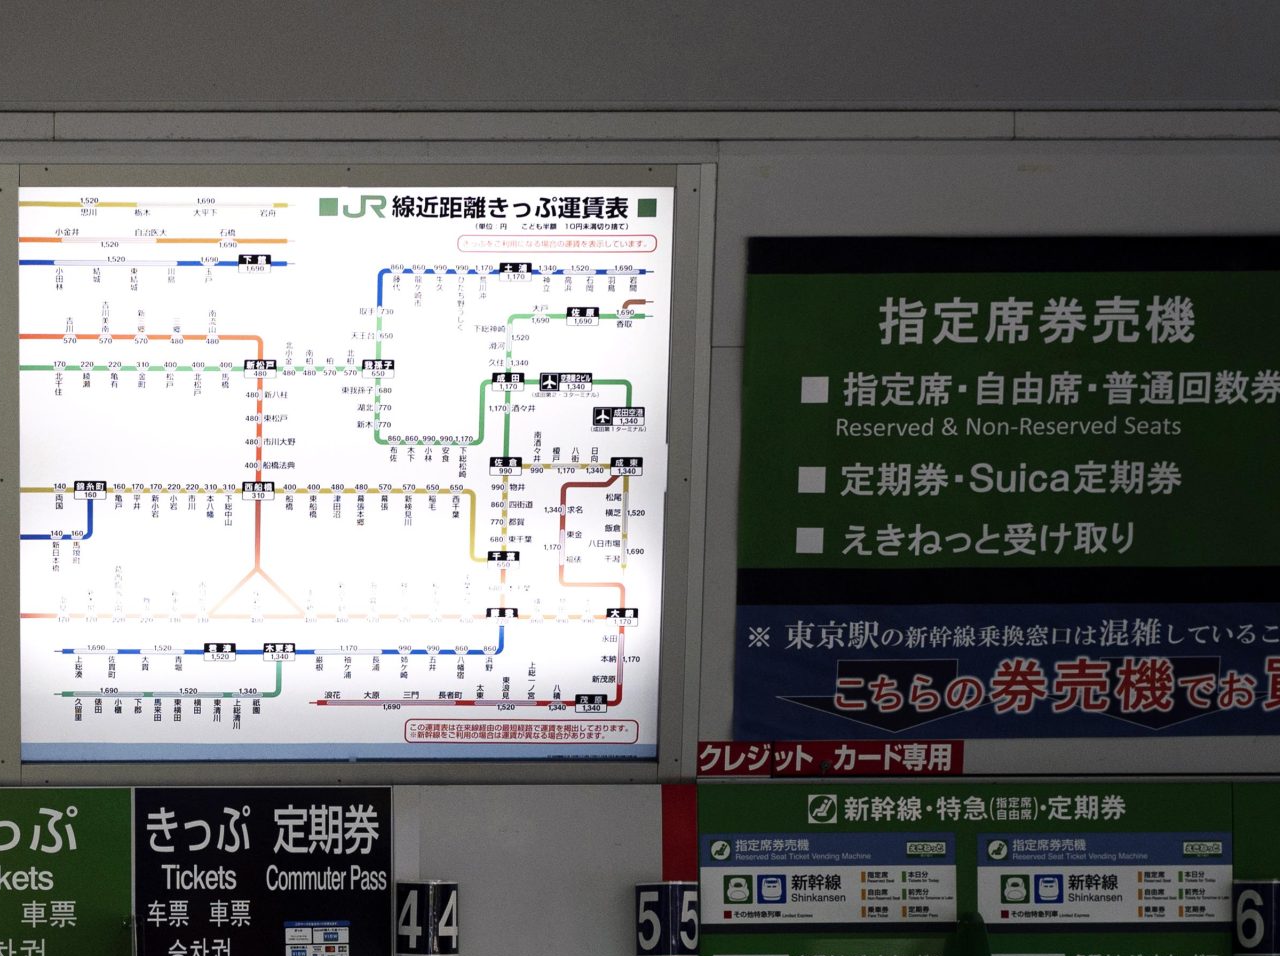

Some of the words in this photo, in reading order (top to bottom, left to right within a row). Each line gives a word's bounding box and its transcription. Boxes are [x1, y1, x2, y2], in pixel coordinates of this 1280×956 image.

[392, 196, 629, 220] 線近距離きっぷ運賃表
[879, 295, 1196, 345] 指定席券売機
[842, 371, 1280, 408] 指定席・自由席・普通回数券
[613, 408, 644, 417] 成田空港
[835, 417, 935, 437] Reserved
[941, 418, 958, 436] &
[966, 416, 1117, 436] Non-Reserved
[1124, 416, 1182, 435] Seats
[263, 437, 296, 446] 市川大野
[840, 461, 1182, 496] 定期券・Suica定期券
[508, 500, 534, 509] 四街道
[841, 522, 1135, 557] えきねっと受け取り
[699, 744, 814, 773] クレジット
[833, 743, 952, 772] カード専用
[145, 805, 251, 854] きっぷ
[272, 805, 380, 855] 定期券
[735, 839, 810, 852] 指定席券売機
[1012, 839, 1087, 852] 指定席券売機
[735, 853, 769, 861] Reserved
[770, 853, 787, 861] Seat
[790, 853, 810, 861] Ticket
[811, 853, 840, 862] Vending
[1012, 853, 1047, 861] Reserved
[1048, 853, 1065, 861] Seat
[1066, 853, 1087, 861] Ticket
[1088, 853, 1117, 862] Vending
[161, 863, 237, 892] Tickets
[265, 864, 345, 892] Commuter
[349, 864, 387, 892] Pass
[791, 874, 842, 891] 新幹線
[867, 871, 888, 879] 指定席
[907, 871, 929, 879] 本日分
[1068, 874, 1119, 890] 新幹線
[1144, 871, 1165, 879] 指定席
[791, 892, 847, 903] Shinkansen
[867, 888, 888, 896] 自由席
[1068, 892, 1123, 903] Shinkansen
[1144, 888, 1164, 896] 自由席
[20, 900, 77, 929] 車票
[146, 900, 190, 928] 车票
[208, 900, 251, 928] 車票
[397, 889, 422, 948] 4
[438, 888, 458, 948] 4
[637, 891, 661, 950] 5
[679, 891, 699, 950] 5
[733, 910, 782, 919] その他特急列車
[1010, 910, 1059, 919] その他特急列車
[1237, 889, 1264, 948] 6
